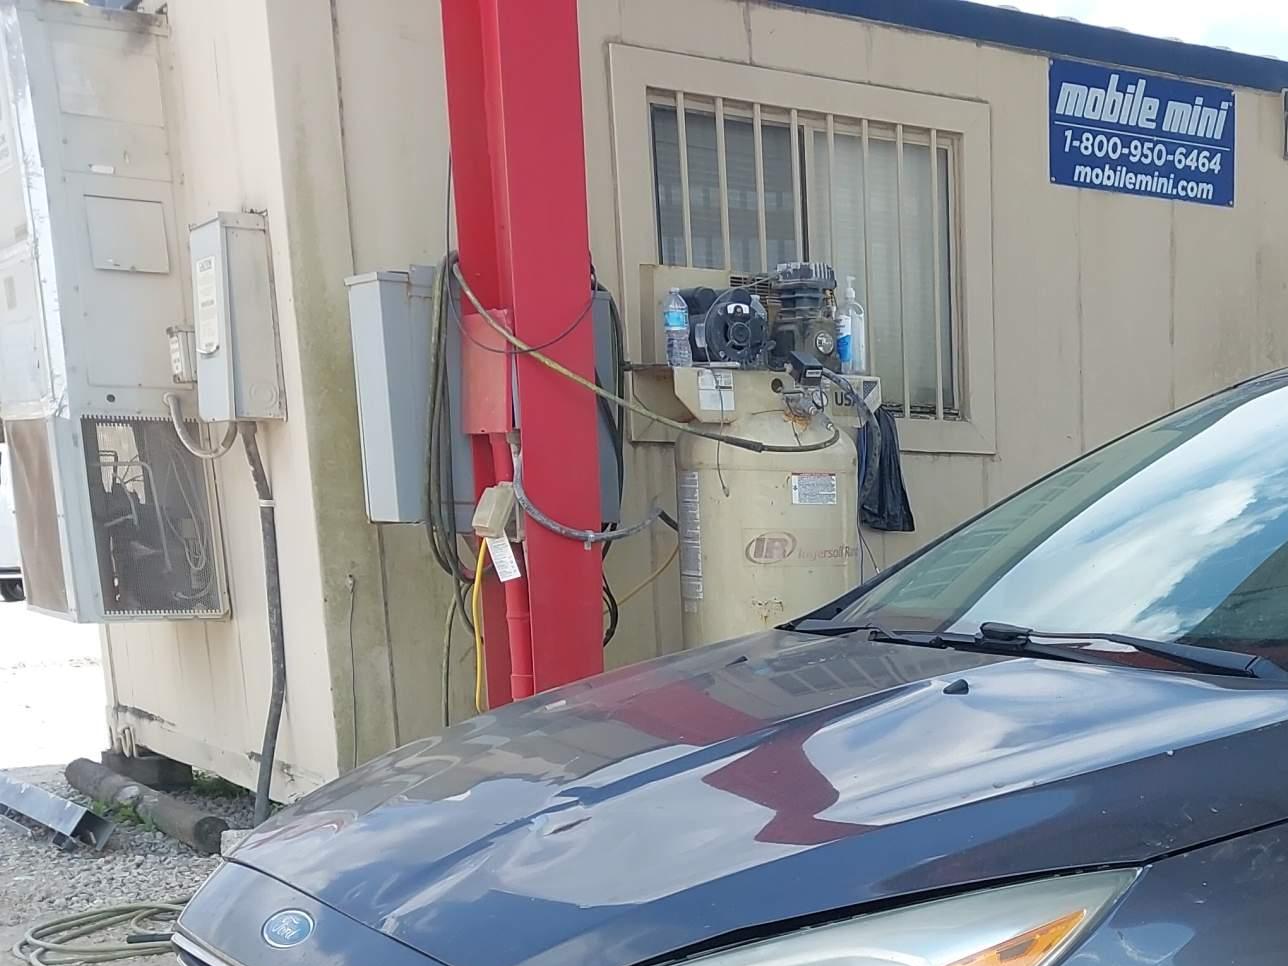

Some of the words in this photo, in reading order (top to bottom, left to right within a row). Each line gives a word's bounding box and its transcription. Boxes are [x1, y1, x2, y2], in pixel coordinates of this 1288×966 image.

[1056, 74, 1159, 129] mobile
[1162, 97, 1228, 139] mini
[1064, 129, 1221, 174] 1-800-950-6464
[1073, 164, 1213, 200] mobilemini.com
